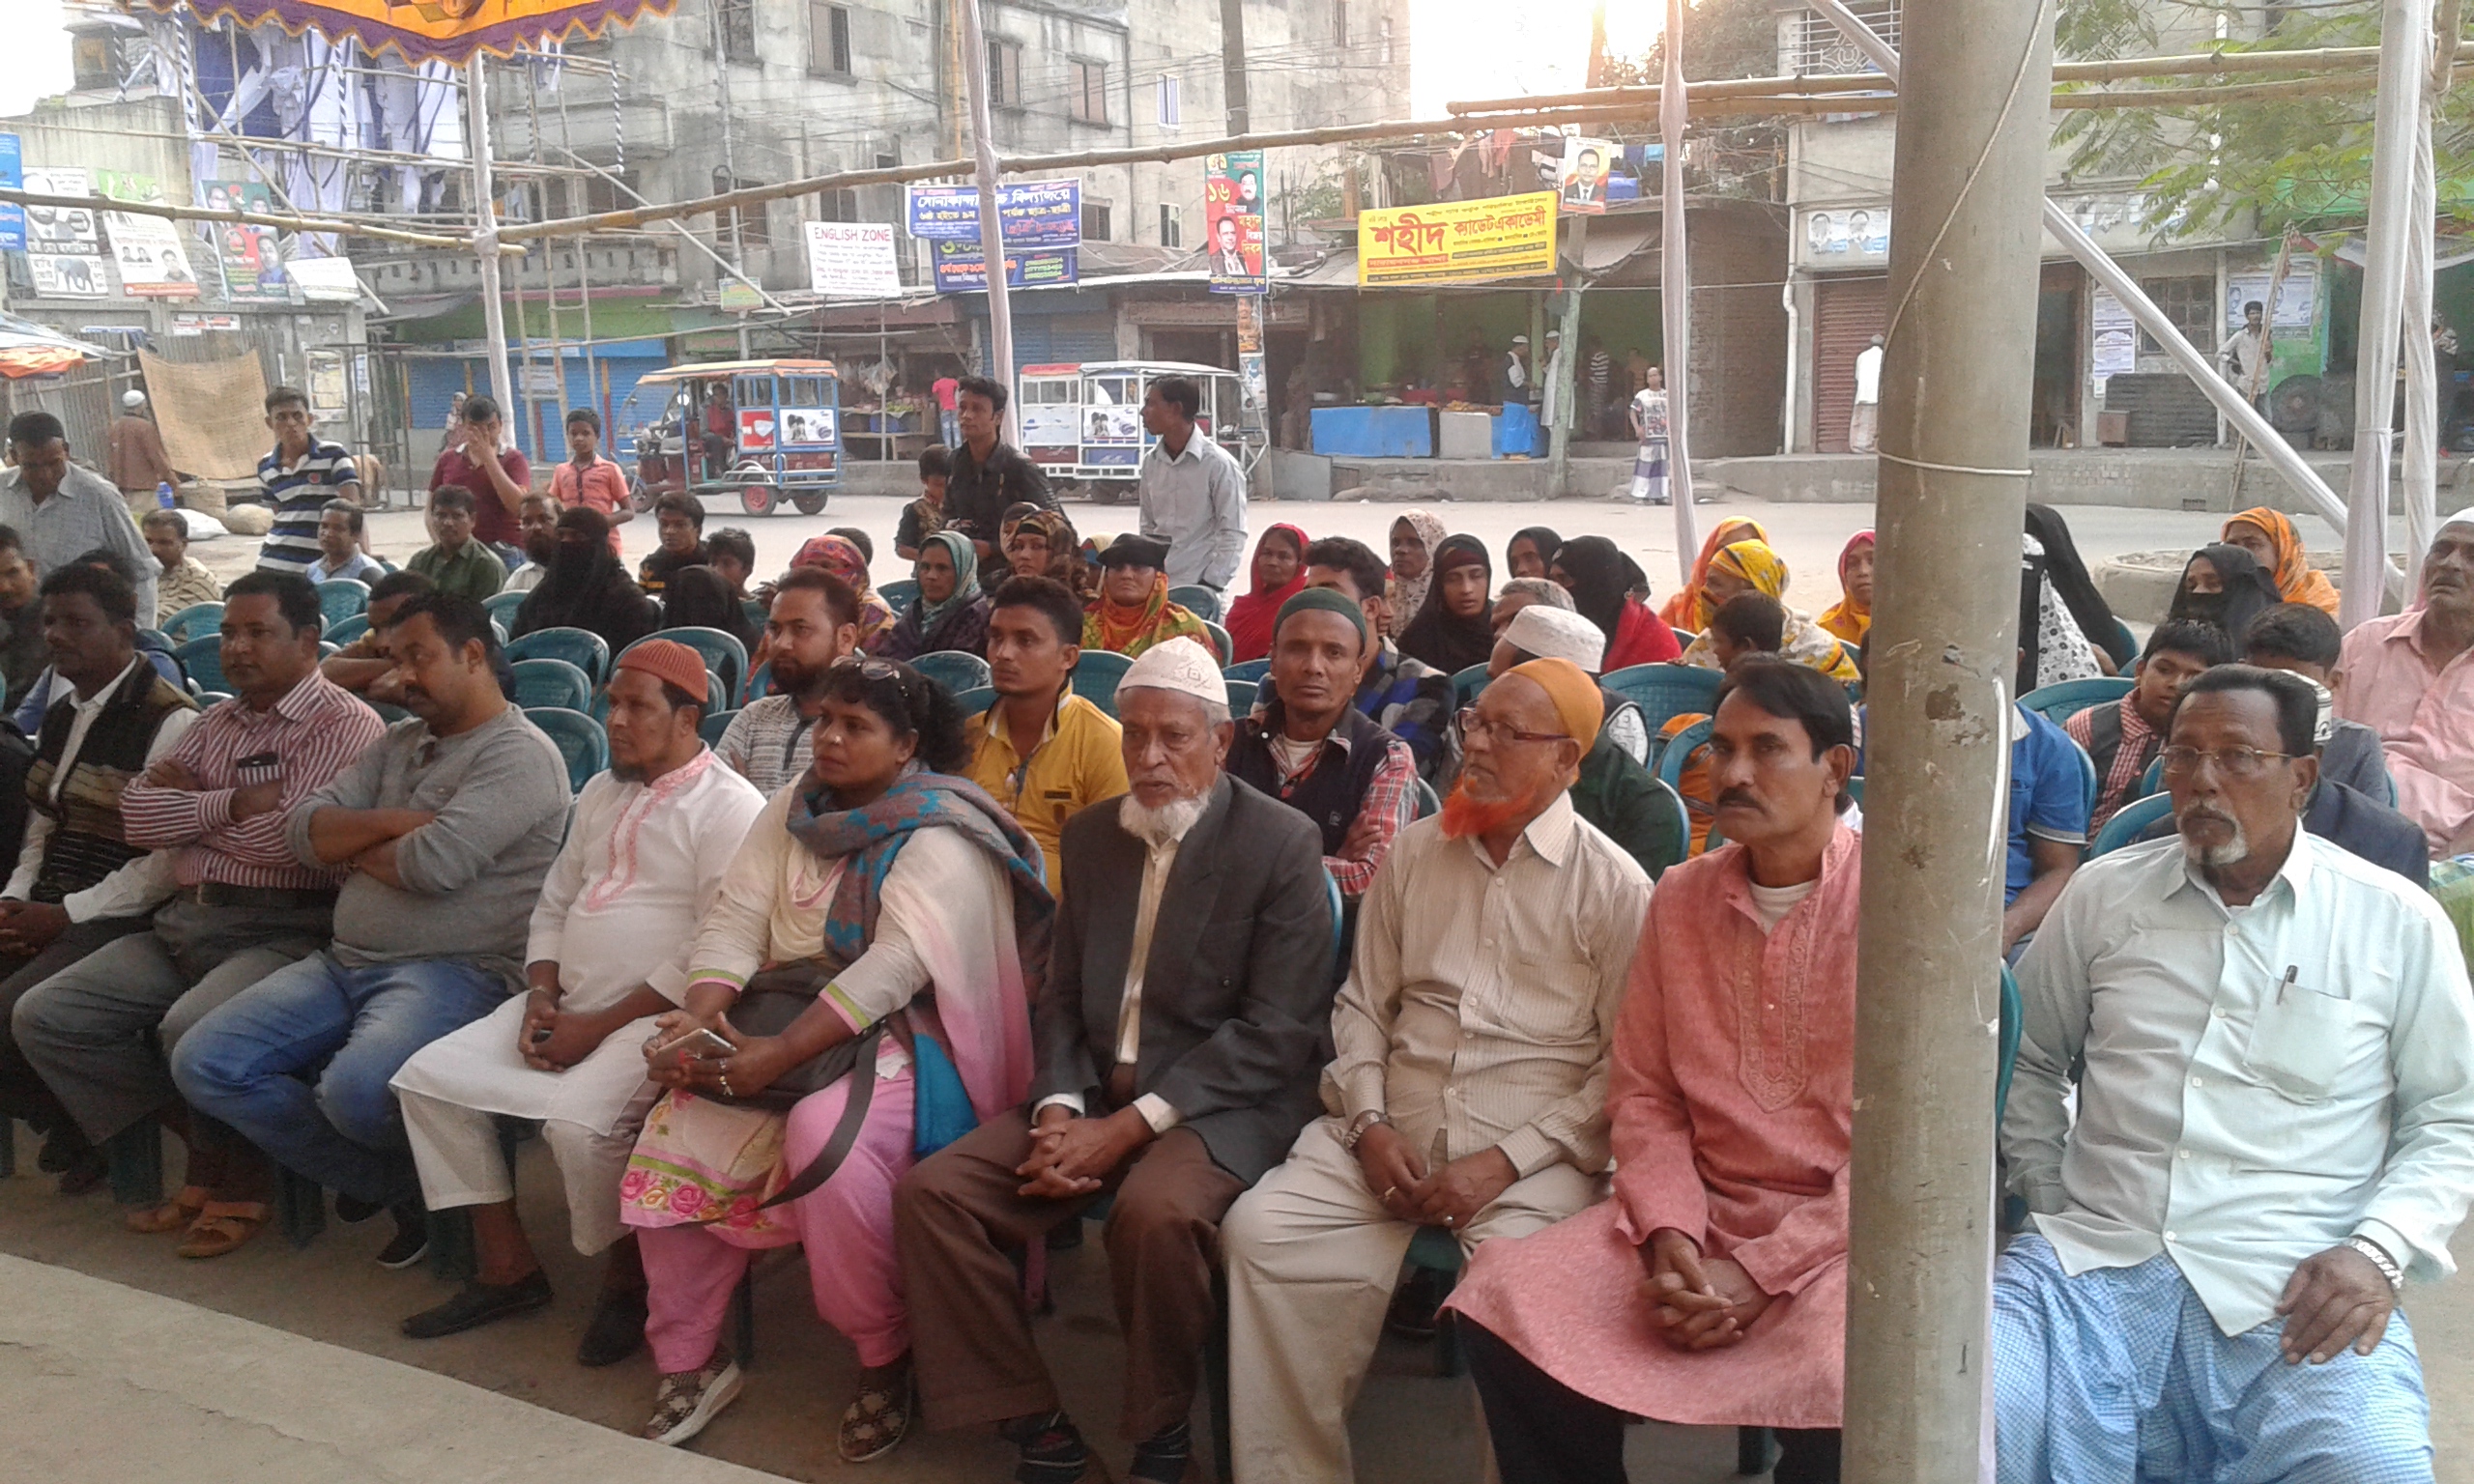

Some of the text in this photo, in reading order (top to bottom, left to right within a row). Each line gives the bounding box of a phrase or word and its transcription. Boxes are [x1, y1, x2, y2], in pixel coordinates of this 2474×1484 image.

[1208, 183, 1230, 202] ১৬
[814, 227, 892, 242] ENGLISH ZONE
[1368, 213, 1450, 256] শহীদ
